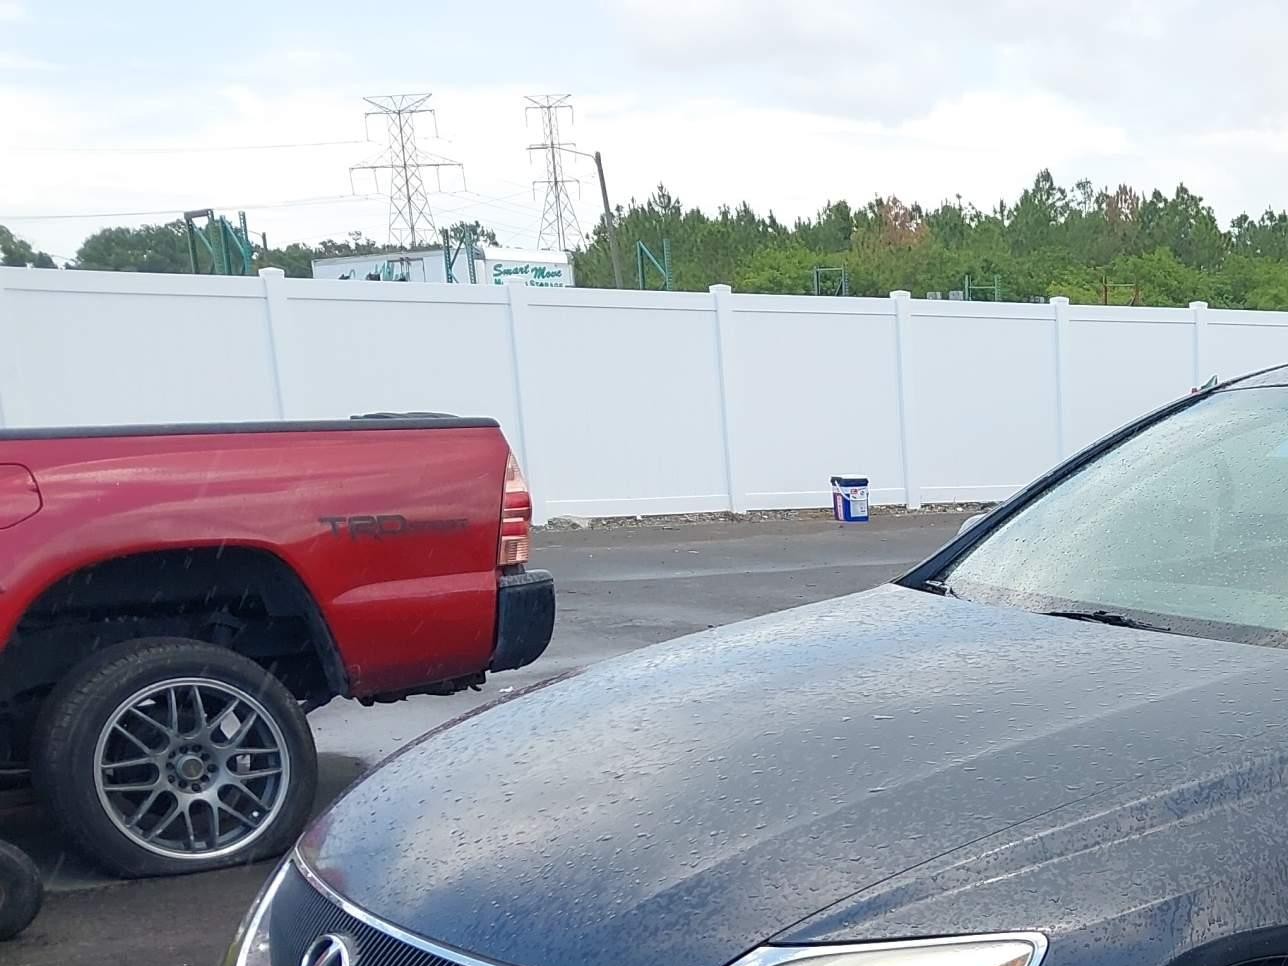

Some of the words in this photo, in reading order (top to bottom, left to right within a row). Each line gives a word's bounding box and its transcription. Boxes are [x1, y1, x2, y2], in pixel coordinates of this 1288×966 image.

[493, 263, 530, 277] Smart
[530, 266, 562, 279] Move
[318, 514, 407, 543] TRD
